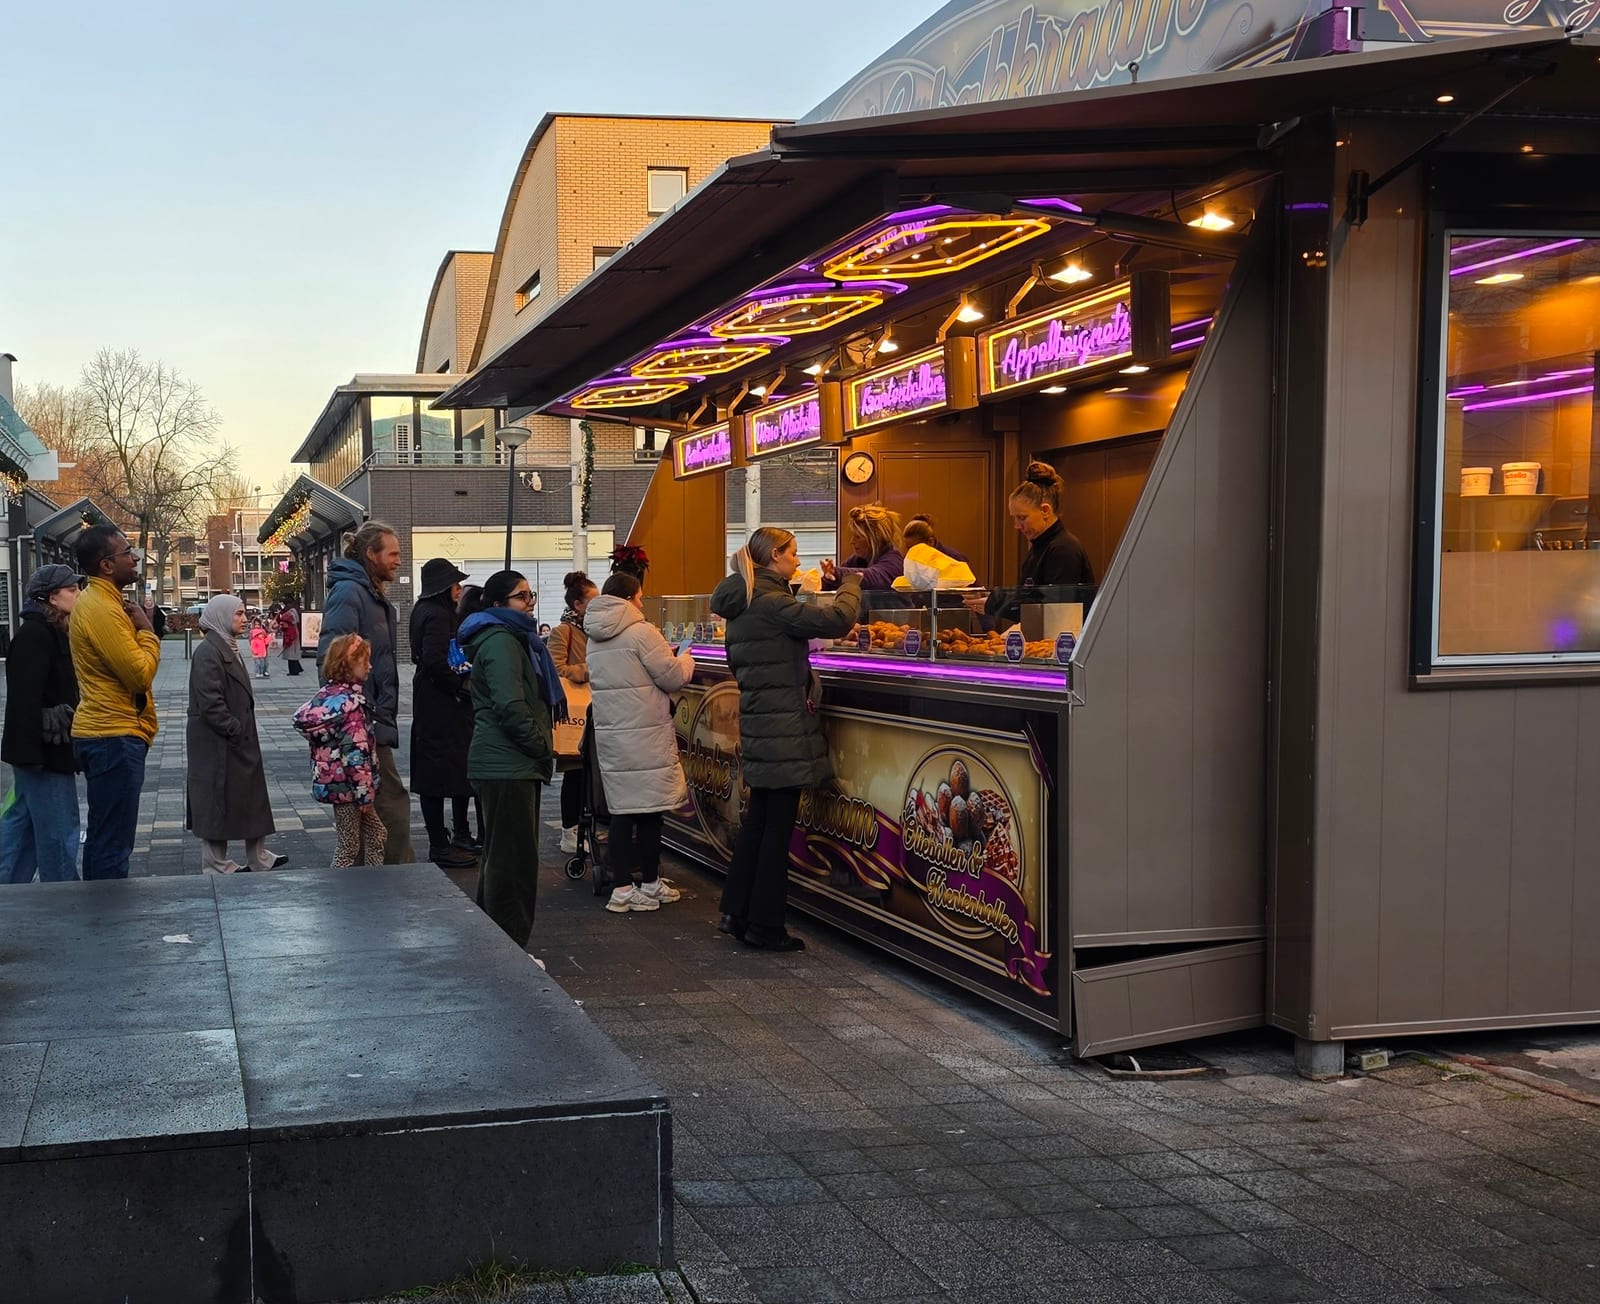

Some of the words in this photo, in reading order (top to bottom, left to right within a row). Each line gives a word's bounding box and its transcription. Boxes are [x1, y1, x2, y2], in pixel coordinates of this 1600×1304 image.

[902, 812, 967, 873] Oliebollen
[967, 840, 984, 879] &
[926, 866, 1019, 944] Krentenbollen
